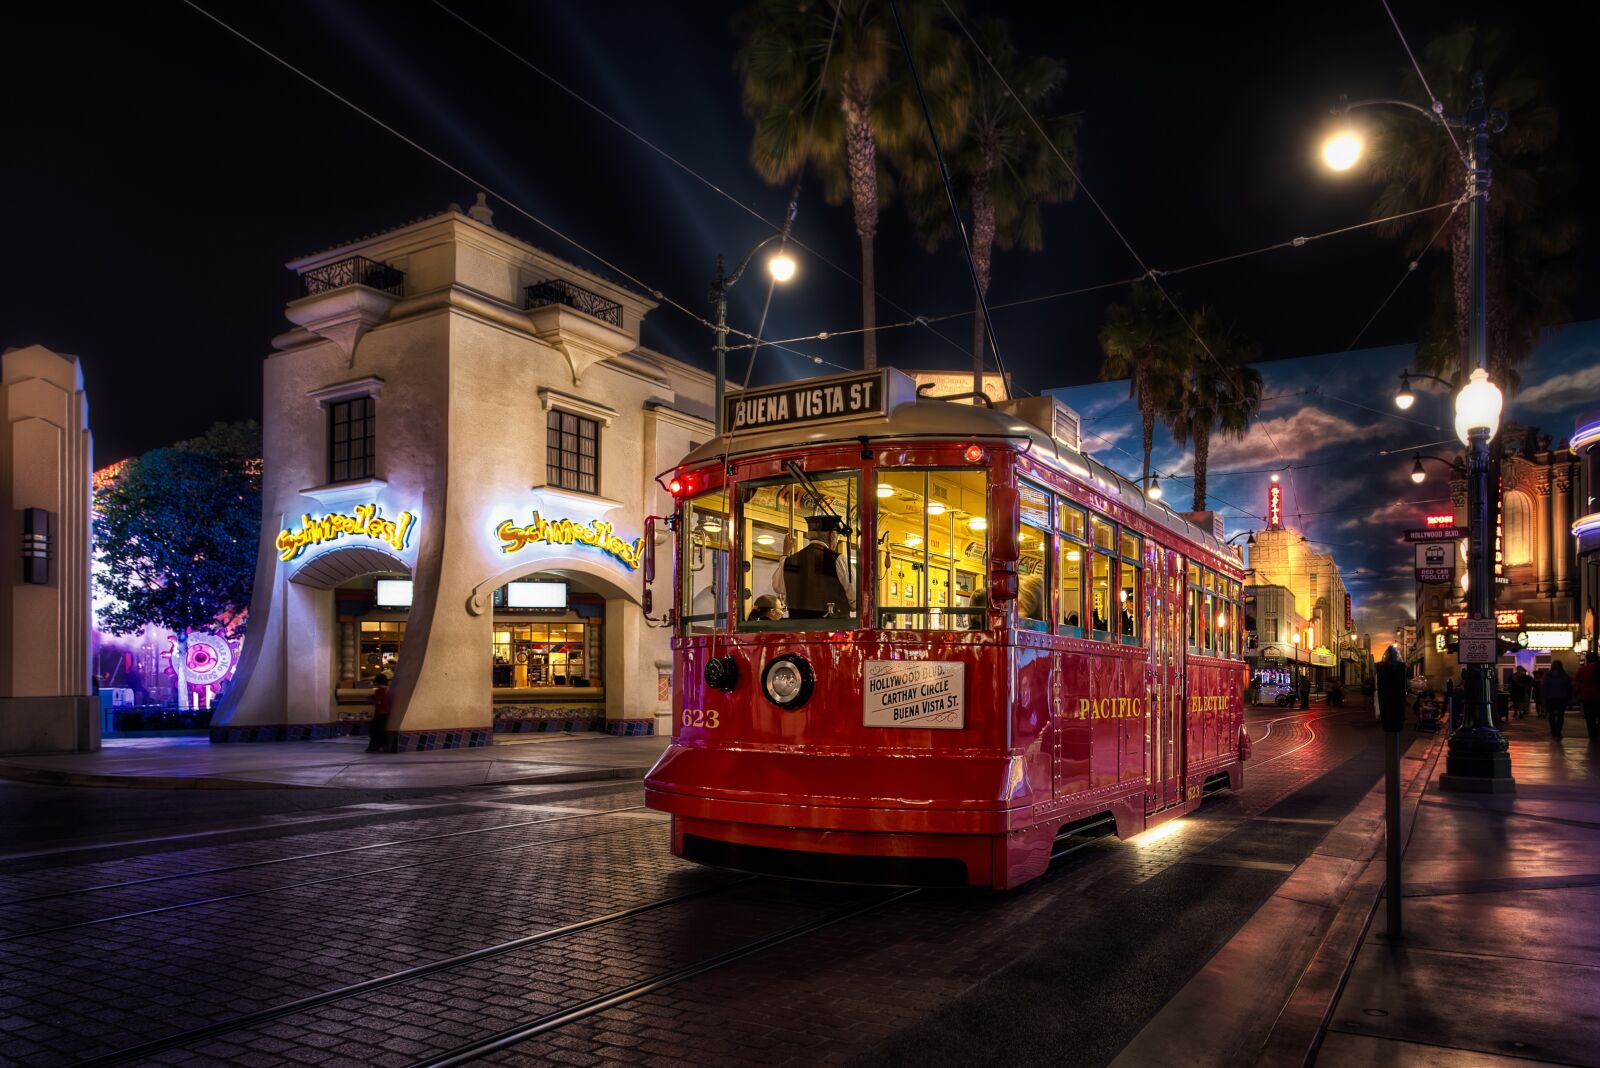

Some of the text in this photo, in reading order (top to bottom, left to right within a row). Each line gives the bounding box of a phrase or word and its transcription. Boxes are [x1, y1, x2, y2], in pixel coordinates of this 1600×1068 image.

[735, 381, 873, 427] BUENA VISTA ST
[869, 665, 945, 692] HOLLYWOOD BLVD.
[881, 680, 949, 706] CARTHAY CIRCLE
[681, 708, 720, 729] 623
[892, 694, 959, 721] BUENA VISTA ST.
[1079, 695, 1230, 720] PACIFIC ELECTRIC
